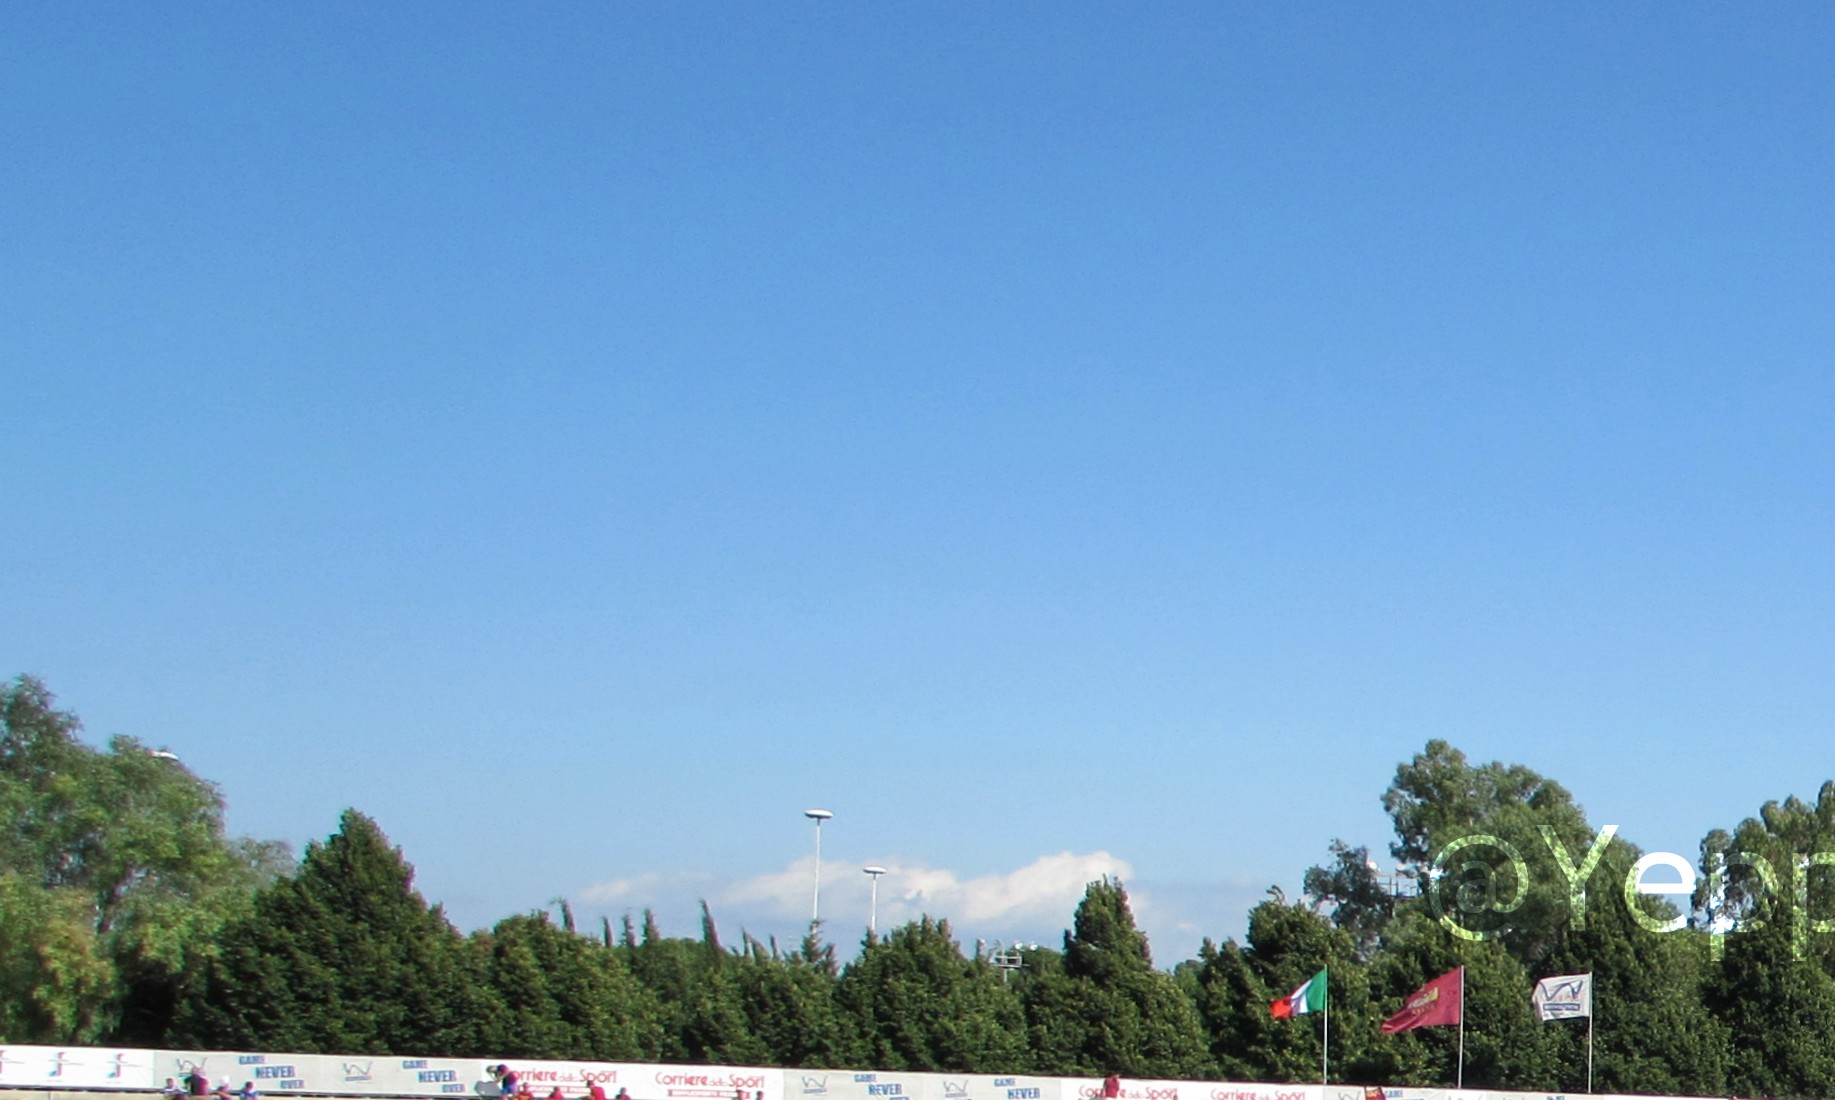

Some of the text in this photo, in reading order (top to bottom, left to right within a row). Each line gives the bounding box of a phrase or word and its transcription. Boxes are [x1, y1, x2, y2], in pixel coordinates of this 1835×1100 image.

[255, 1065, 295, 1079] NEVER
[418, 1070, 457, 1083] NEVER
[868, 1083, 903, 1096] NEVER
[1007, 1087, 1041, 1100] NEVER
